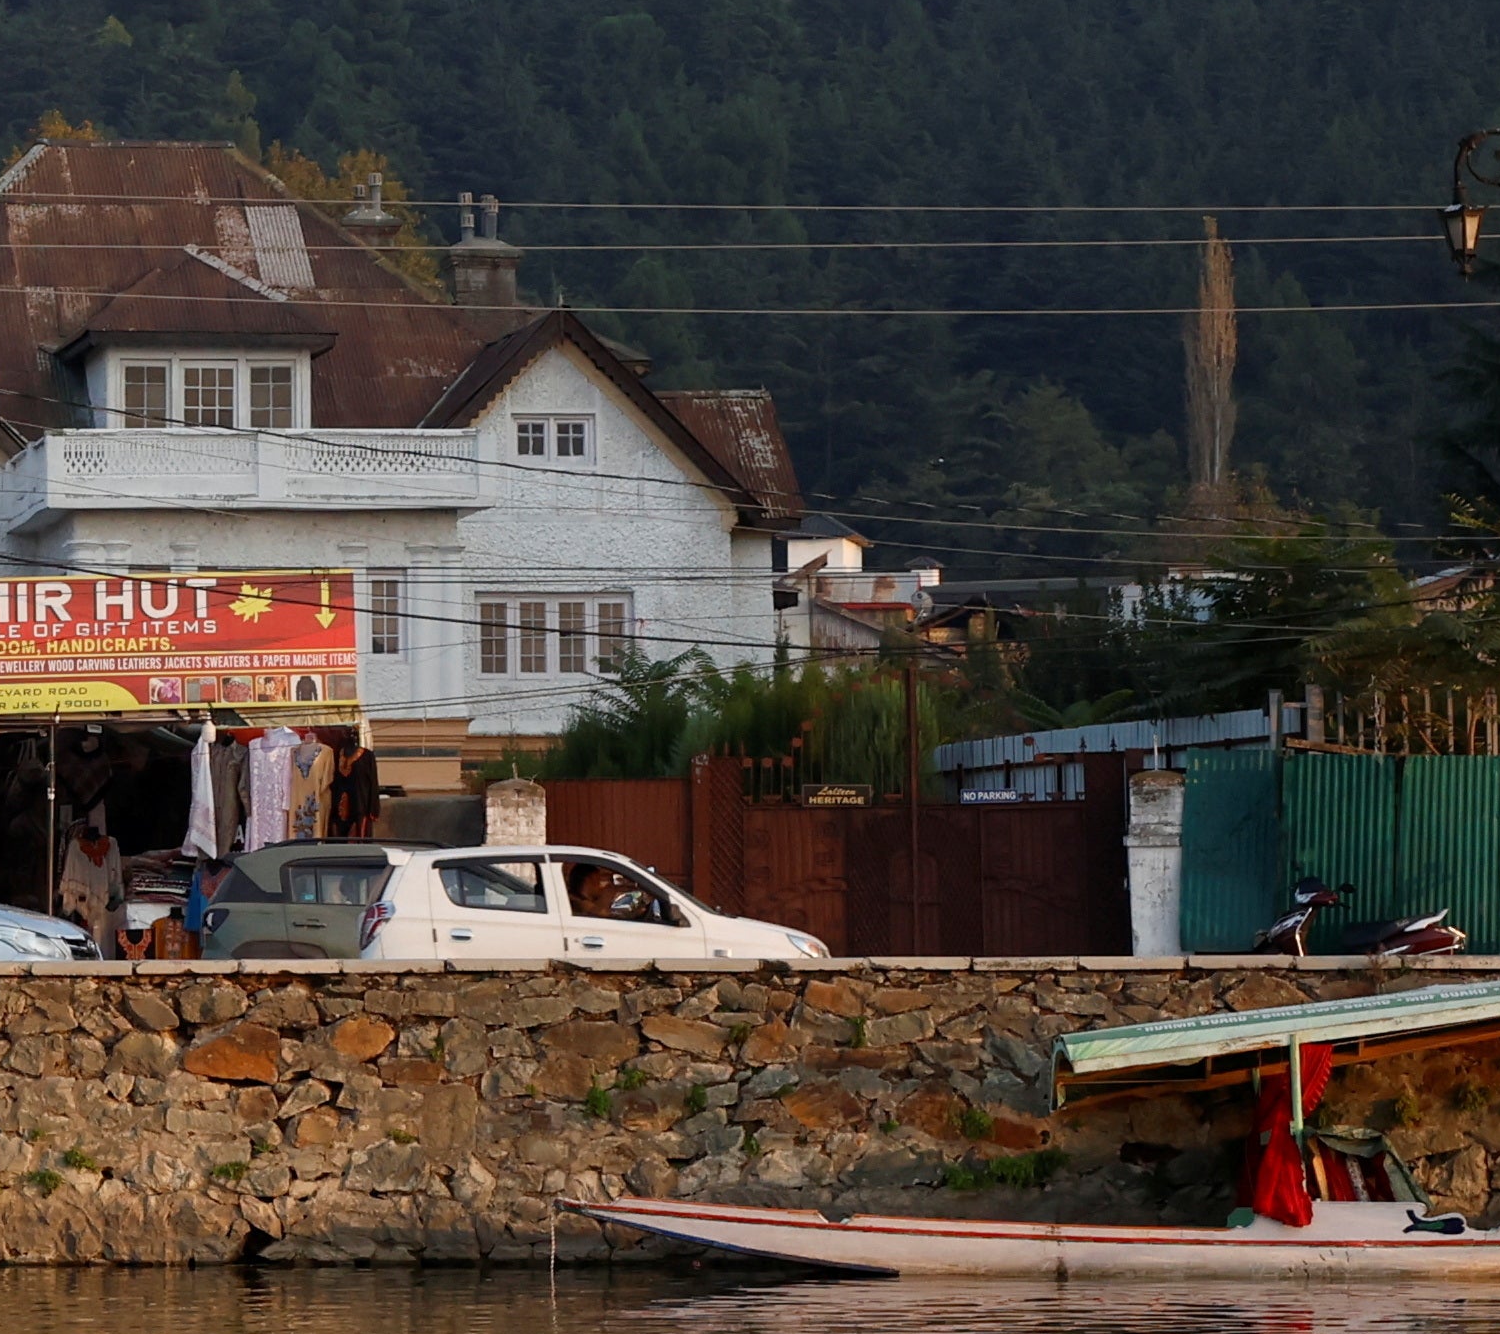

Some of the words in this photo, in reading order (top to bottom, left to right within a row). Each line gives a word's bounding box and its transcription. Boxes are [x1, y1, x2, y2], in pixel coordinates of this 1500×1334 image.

[95, 577, 217, 622] HUT
[34, 623, 64, 638] OF
[76, 622, 131, 637] GIFT
[142, 619, 217, 635] ITEMS
[47, 636, 176, 654] HANDICRAFTS.
[48, 658, 75, 671] WOOD
[77, 658, 115, 671] CARVING
[117, 657, 161, 670] LEATHERS
[164, 655, 202, 669] JACKETS
[204, 654, 250, 668] SWEATERS
[252, 654, 260, 667] &
[262, 654, 290, 667] PAPER
[293, 653, 327, 666] MACHIE
[329, 652, 357, 665] ITEMS
[48, 686, 88, 697] ROAD
[12, 700, 41, 711] J&K
[809, 796, 865, 805] HERITAGE
[963, 792, 976, 801] NO
[978, 790, 1017, 801] PARKING
